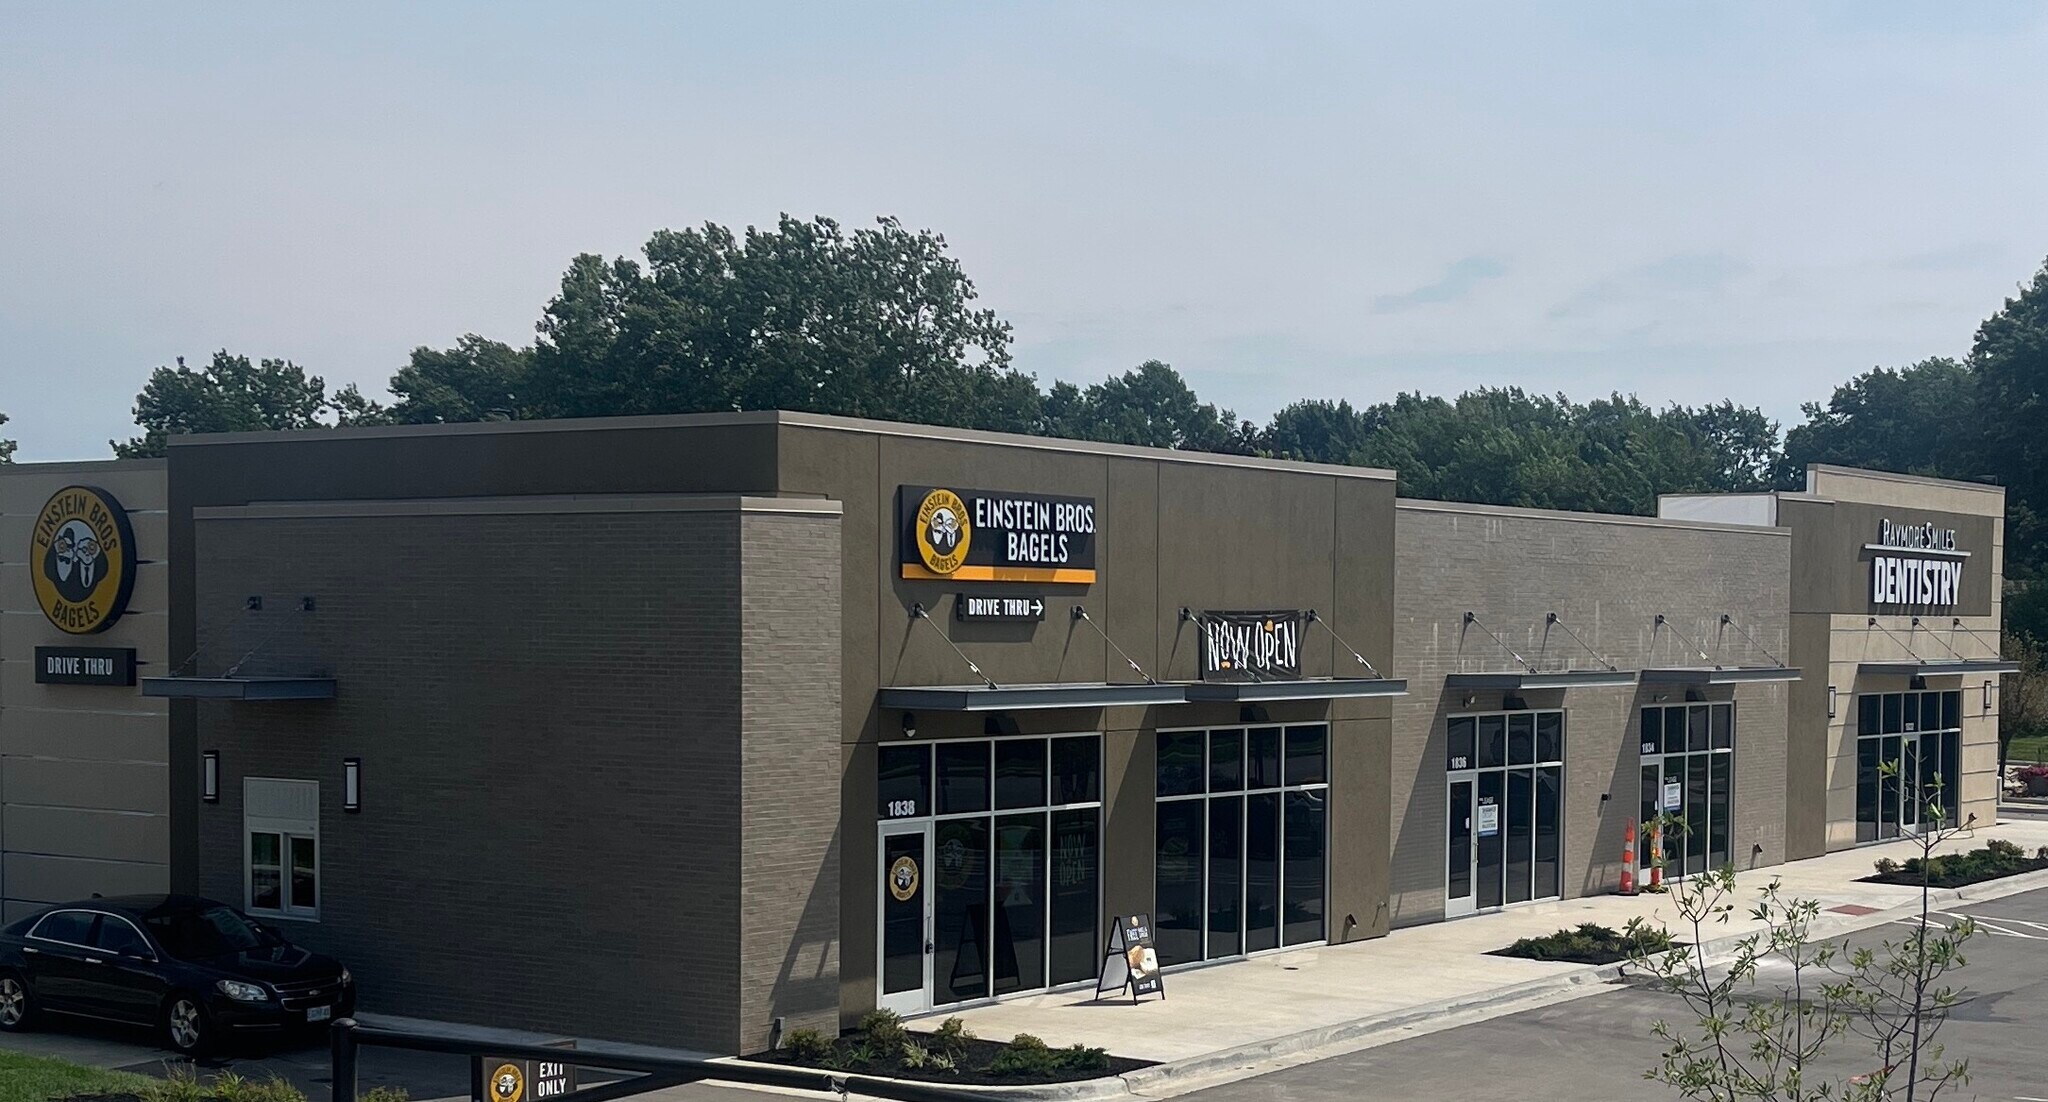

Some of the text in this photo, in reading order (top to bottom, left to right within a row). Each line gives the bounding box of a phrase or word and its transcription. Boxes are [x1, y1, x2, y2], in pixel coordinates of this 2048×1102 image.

[36, 494, 118, 551] EINSTEIN BROS
[976, 498, 1097, 533] EINSTEIN BROS.
[1007, 532, 1068, 563] BAGELS
[929, 553, 959, 572] BAGELS
[1874, 556, 1962, 605] DENTISTRY
[52, 599, 100, 628] BAGELS
[968, 598, 1030, 616] DRIVE THRU
[1207, 620, 1296, 671] NOW OPEN
[47, 656, 113, 676] DRIVE THRU
[1451, 756, 1467, 769] 1836
[887, 800, 915, 816] 1838
[538, 1078, 567, 1097] ONLY
